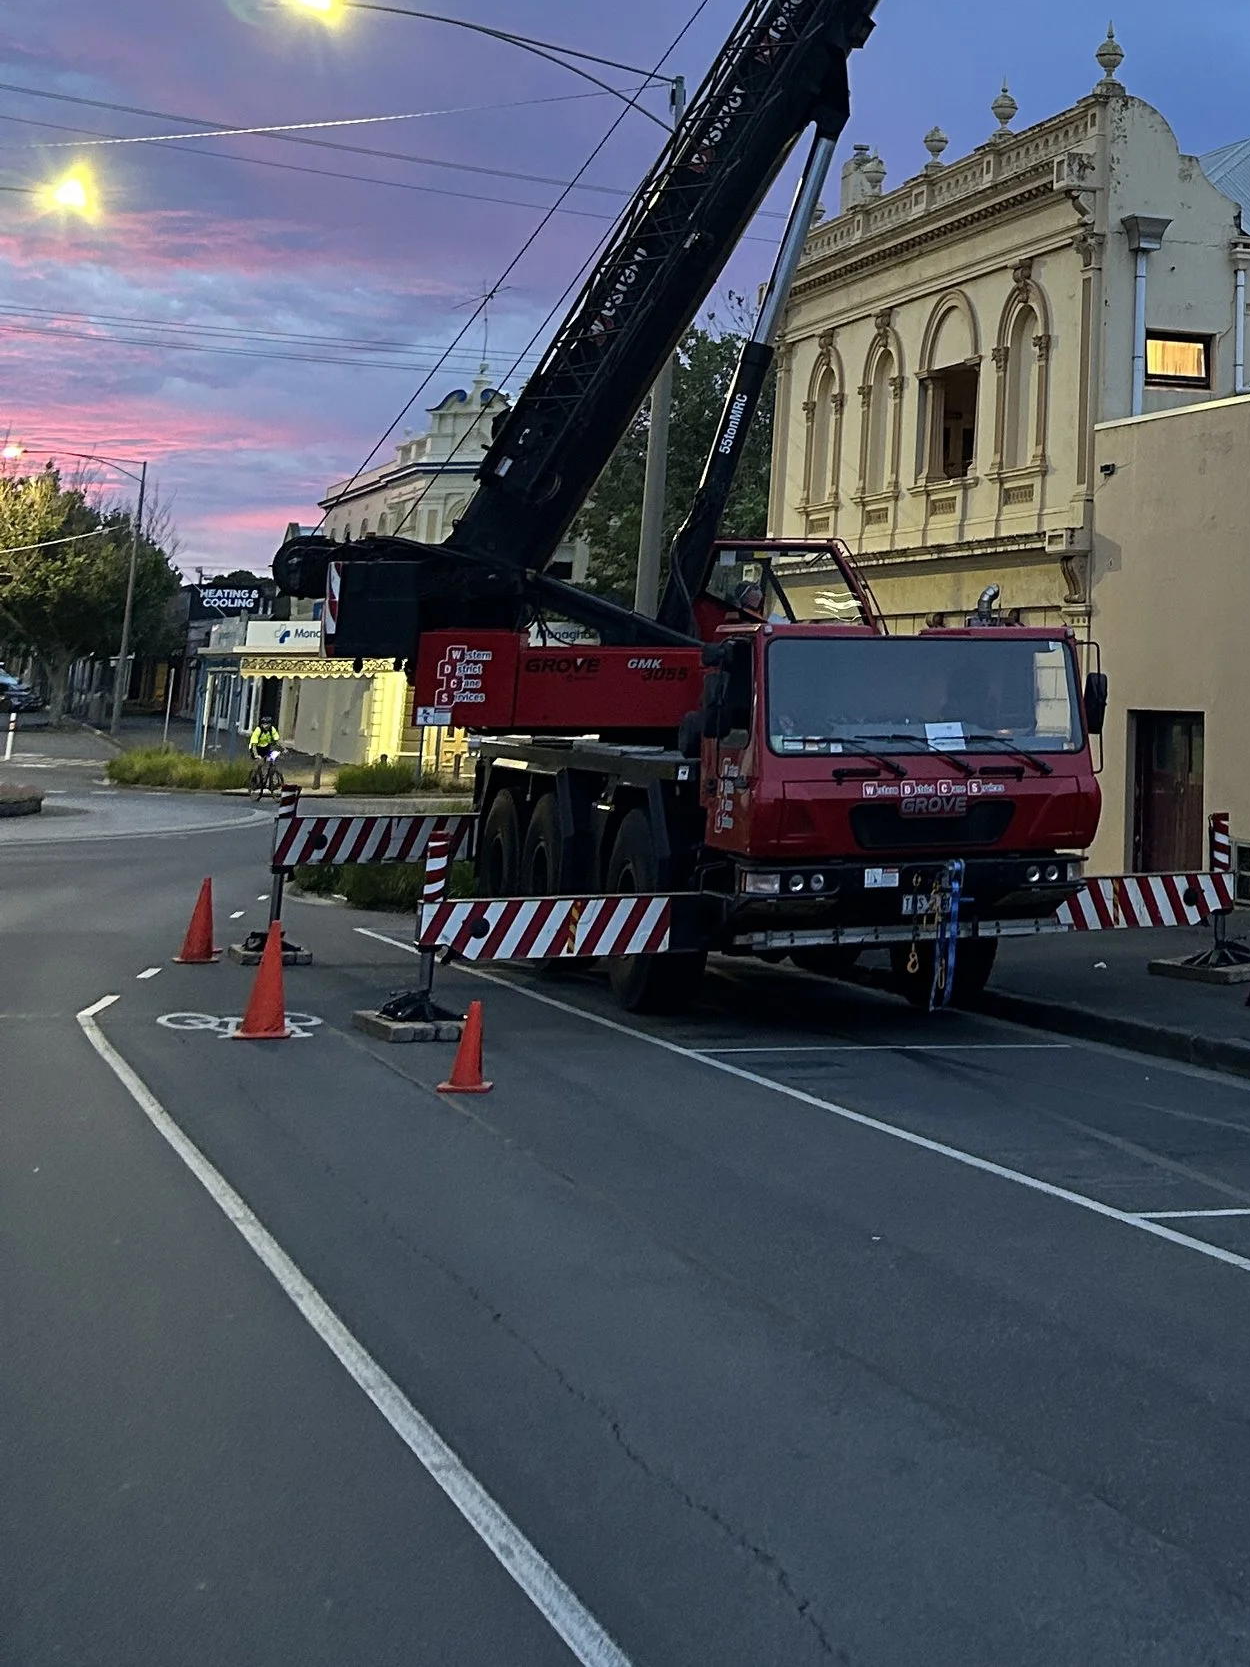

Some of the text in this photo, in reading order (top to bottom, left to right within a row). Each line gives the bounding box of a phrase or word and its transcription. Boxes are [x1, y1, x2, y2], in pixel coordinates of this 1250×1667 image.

[719, 393, 748, 455] 55tonMRC
[200, 588, 259, 599] HEATING &
[203, 598, 255, 608] COOLING
[525, 657, 600, 673] GROVE
[627, 658, 663, 670] GMK
[901, 797, 967, 813] GROVE
